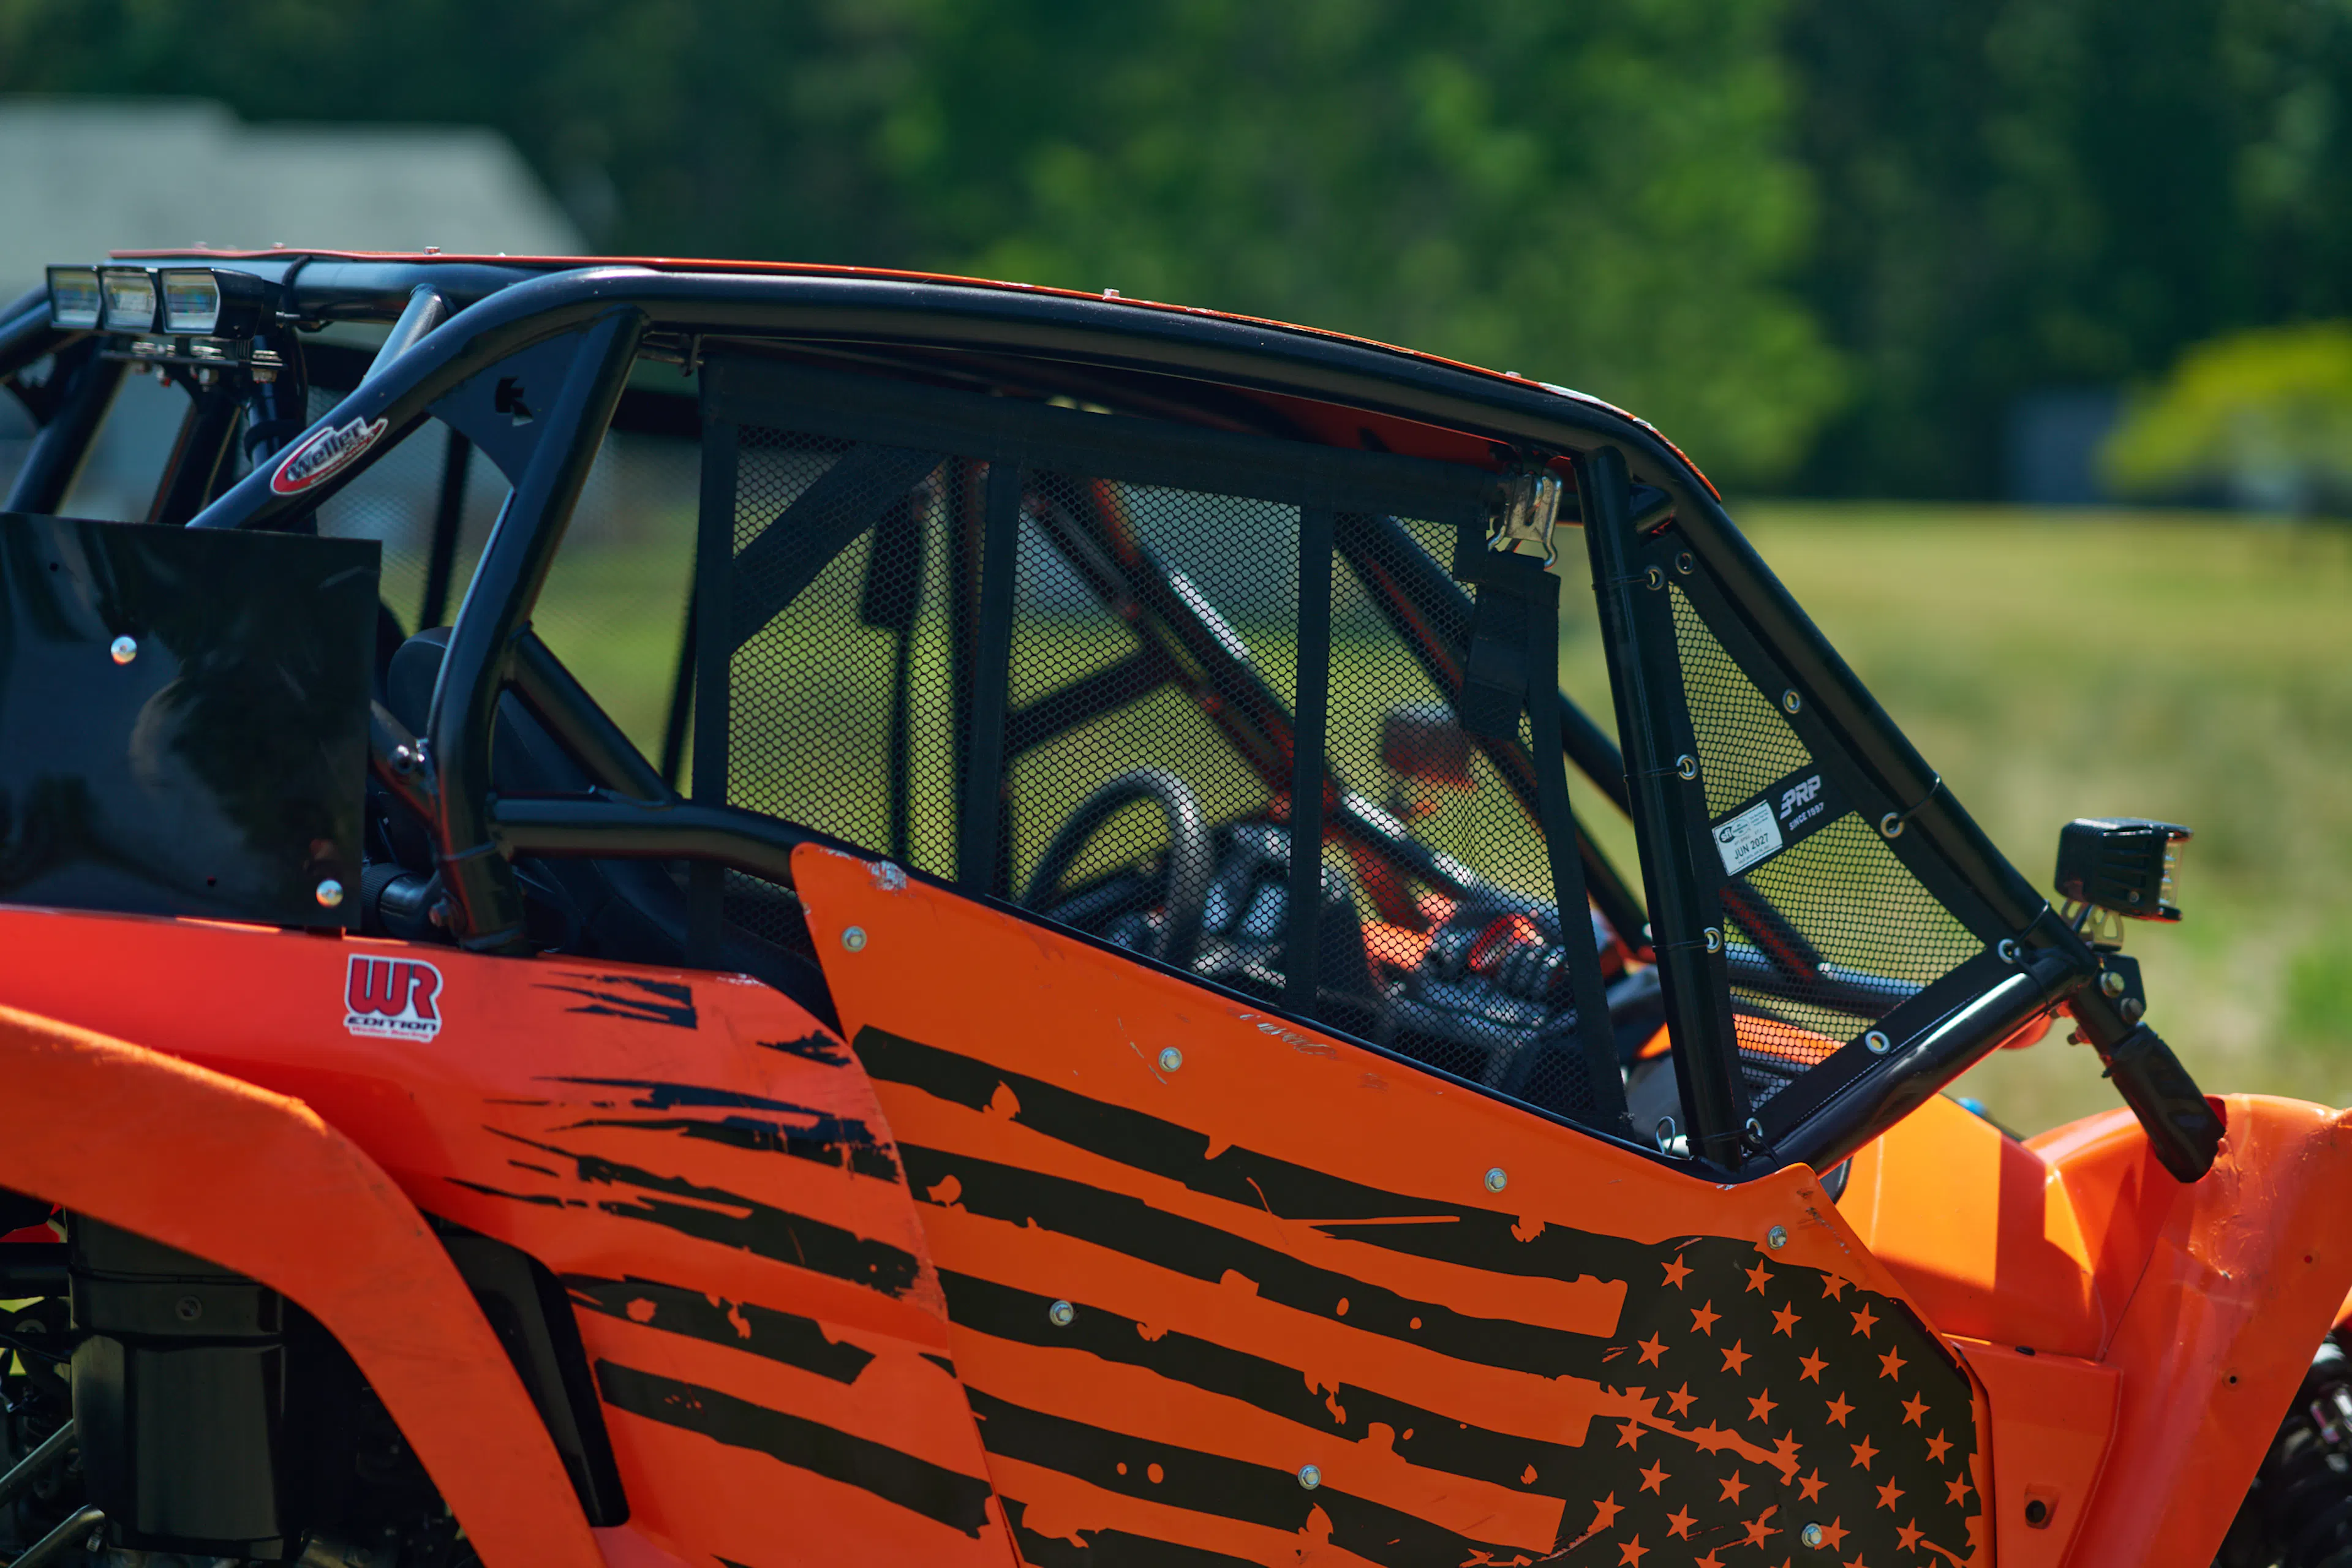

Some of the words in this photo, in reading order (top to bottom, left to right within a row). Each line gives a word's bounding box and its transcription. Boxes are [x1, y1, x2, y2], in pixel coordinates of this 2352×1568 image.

[286, 421, 362, 480] Weller
[1780, 775, 1821, 820] PRP
[1789, 809, 1807, 831] SINCE
[1806, 802, 1825, 818] 1997
[1735, 844, 1749, 859] JUN
[1750, 833, 1769, 850] 2027
[348, 957, 439, 1020] WR
